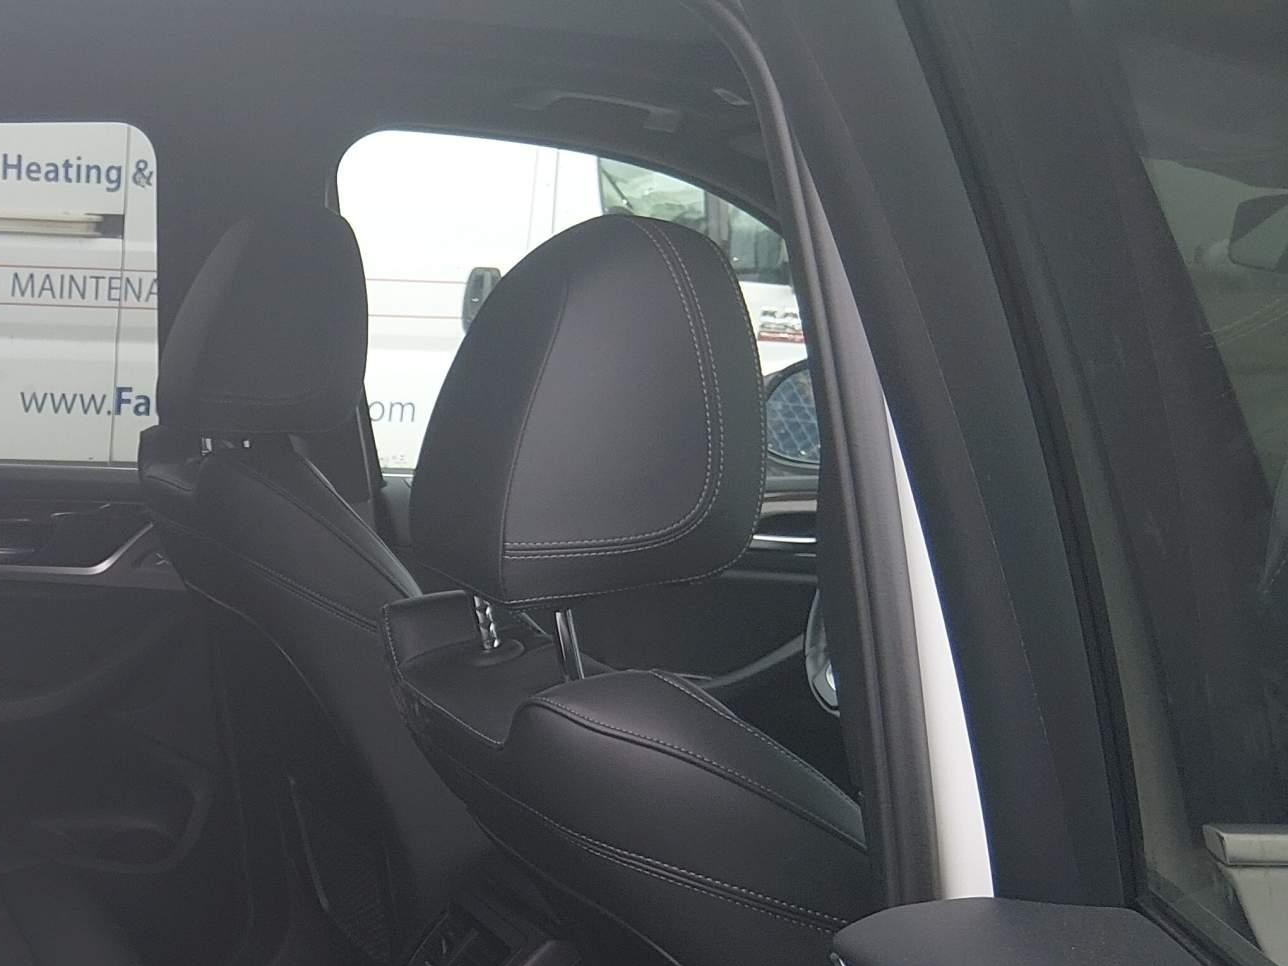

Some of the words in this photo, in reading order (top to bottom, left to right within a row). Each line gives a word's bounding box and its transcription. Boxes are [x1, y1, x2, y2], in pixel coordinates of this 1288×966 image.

[2, 153, 122, 192] Heating
[132, 159, 154, 188] &
[20, 386, 151, 417] www.Fa
